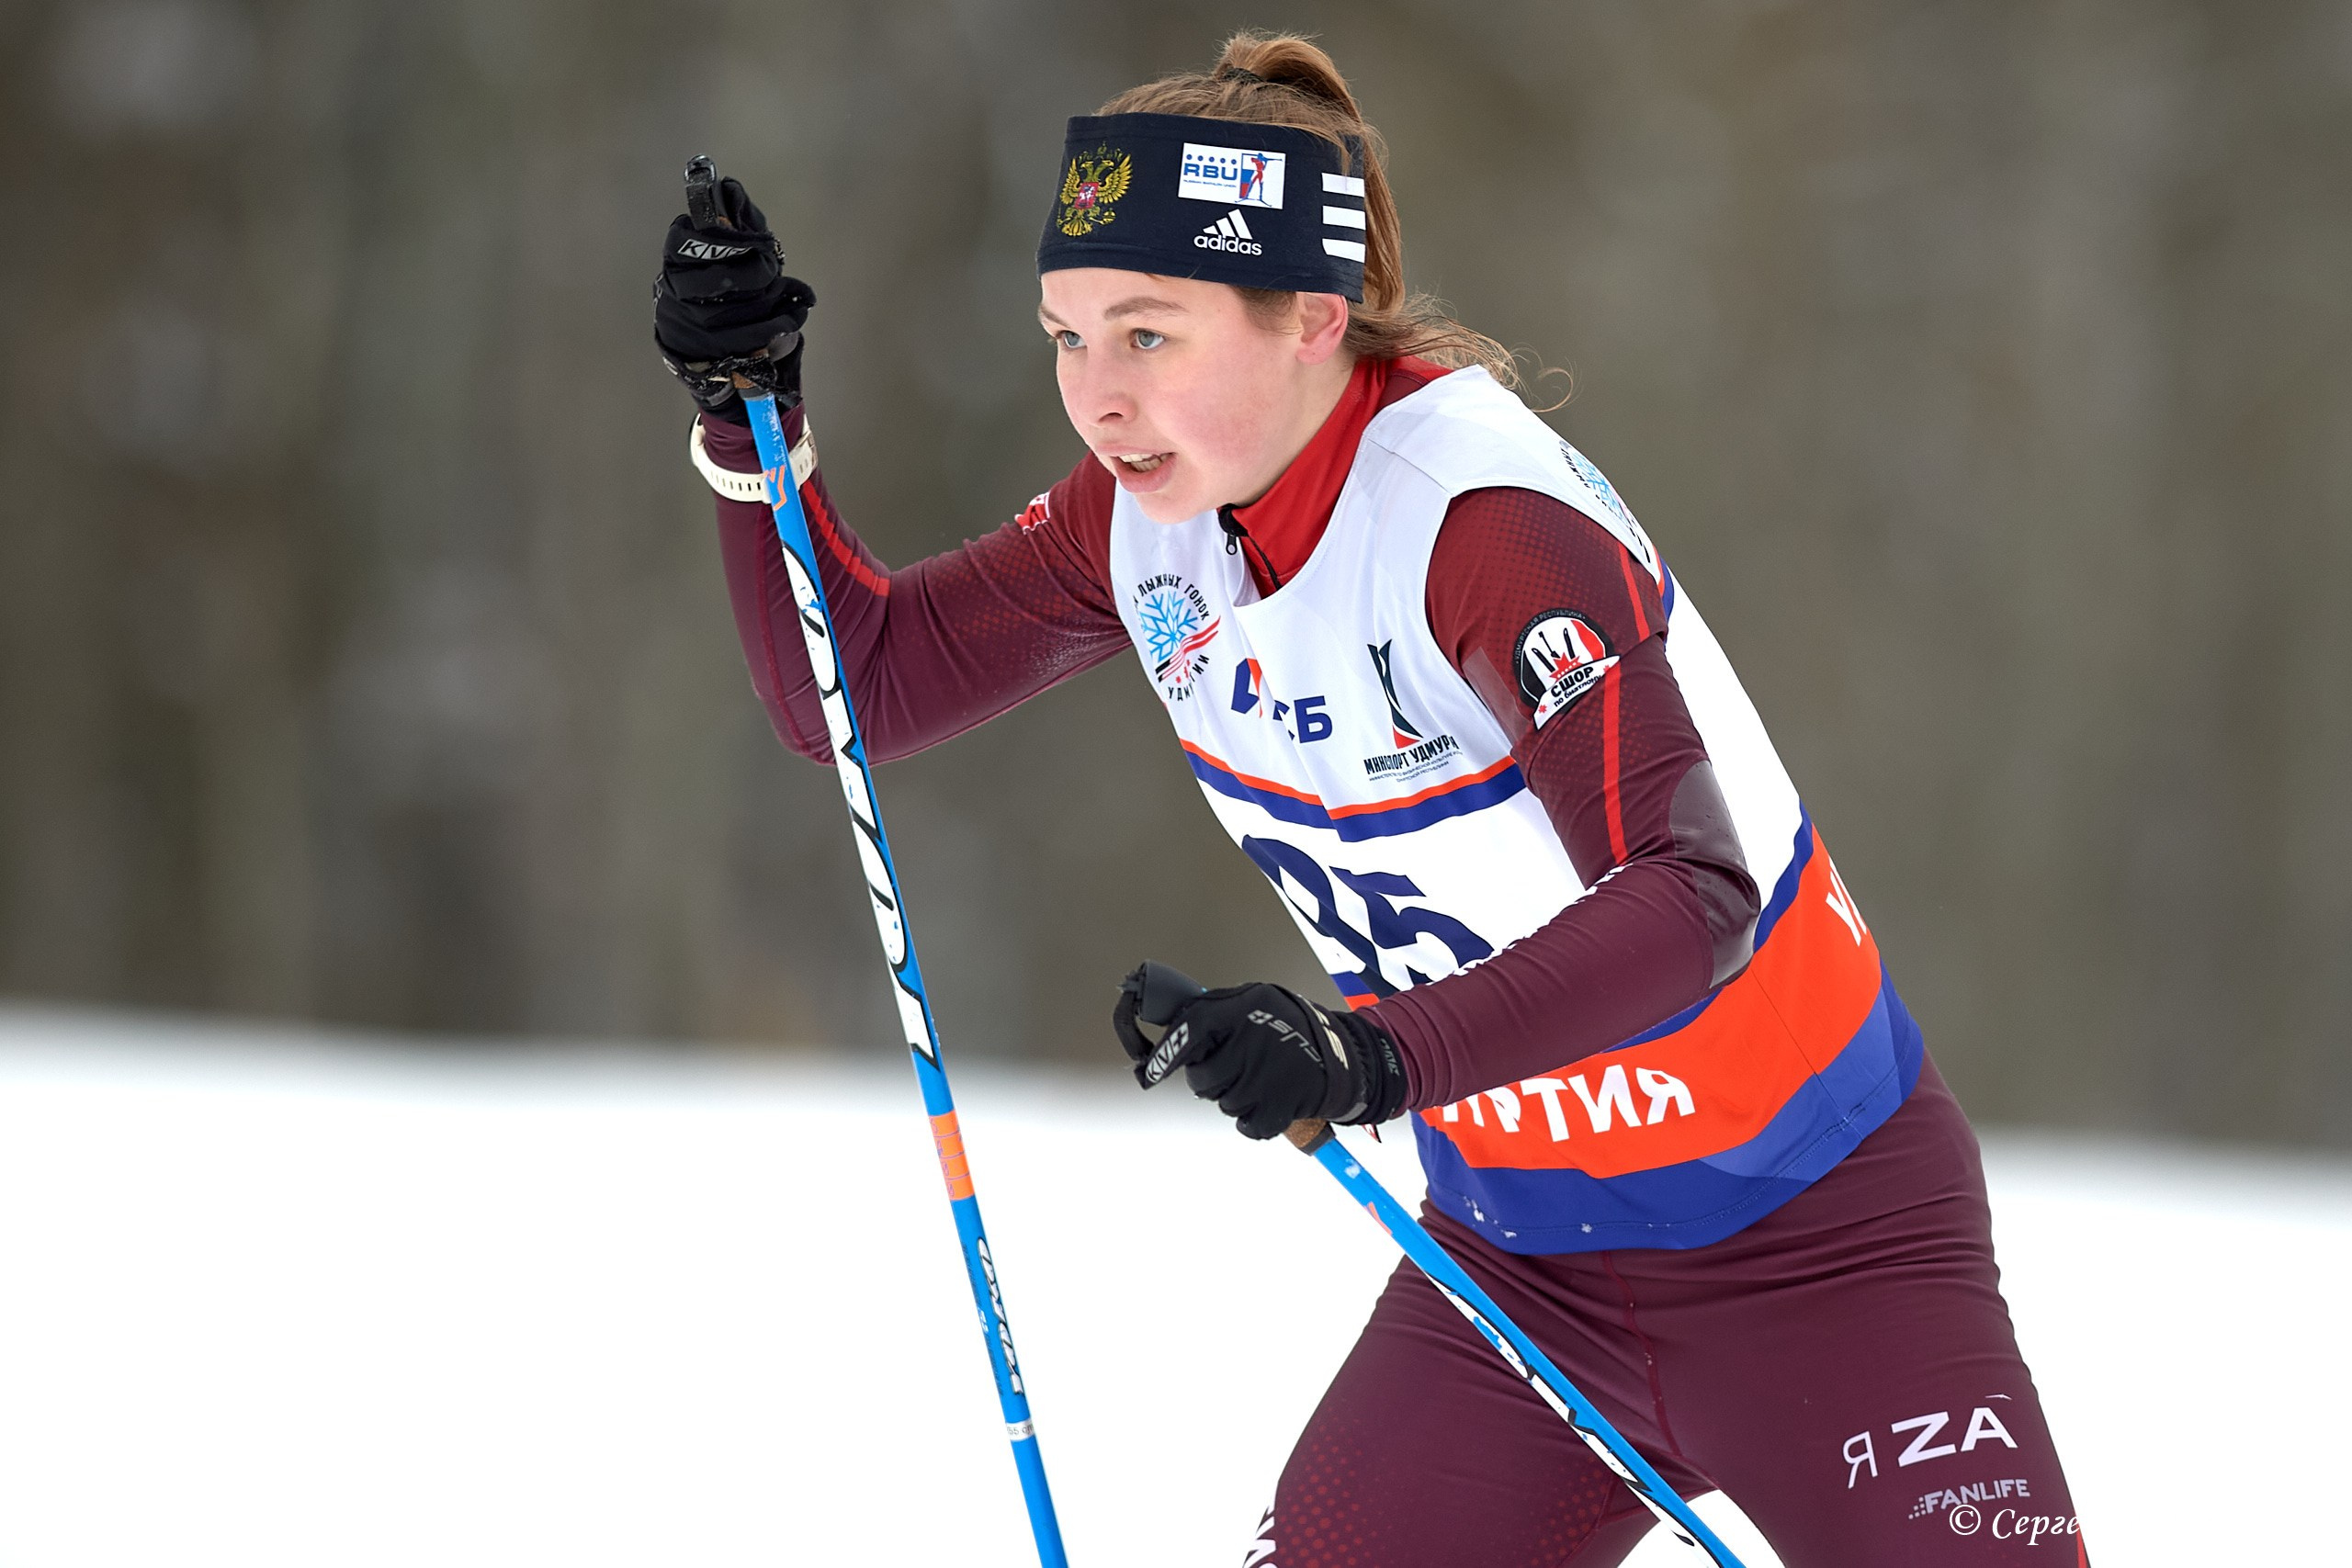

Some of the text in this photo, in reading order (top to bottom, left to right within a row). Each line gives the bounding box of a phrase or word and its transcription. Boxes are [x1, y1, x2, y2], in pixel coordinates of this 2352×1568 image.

[1183, 163, 1238, 181] RBU
[1193, 234, 1262, 256] adidas
[1184, 583, 1210, 621] ГОНОК
[1551, 666, 1594, 698] СШОР
[1554, 697, 1564, 707] по
[1363, 752, 1409, 775] МИНСПОРТ
[1924, 1479, 2030, 1515] FANLIFE
